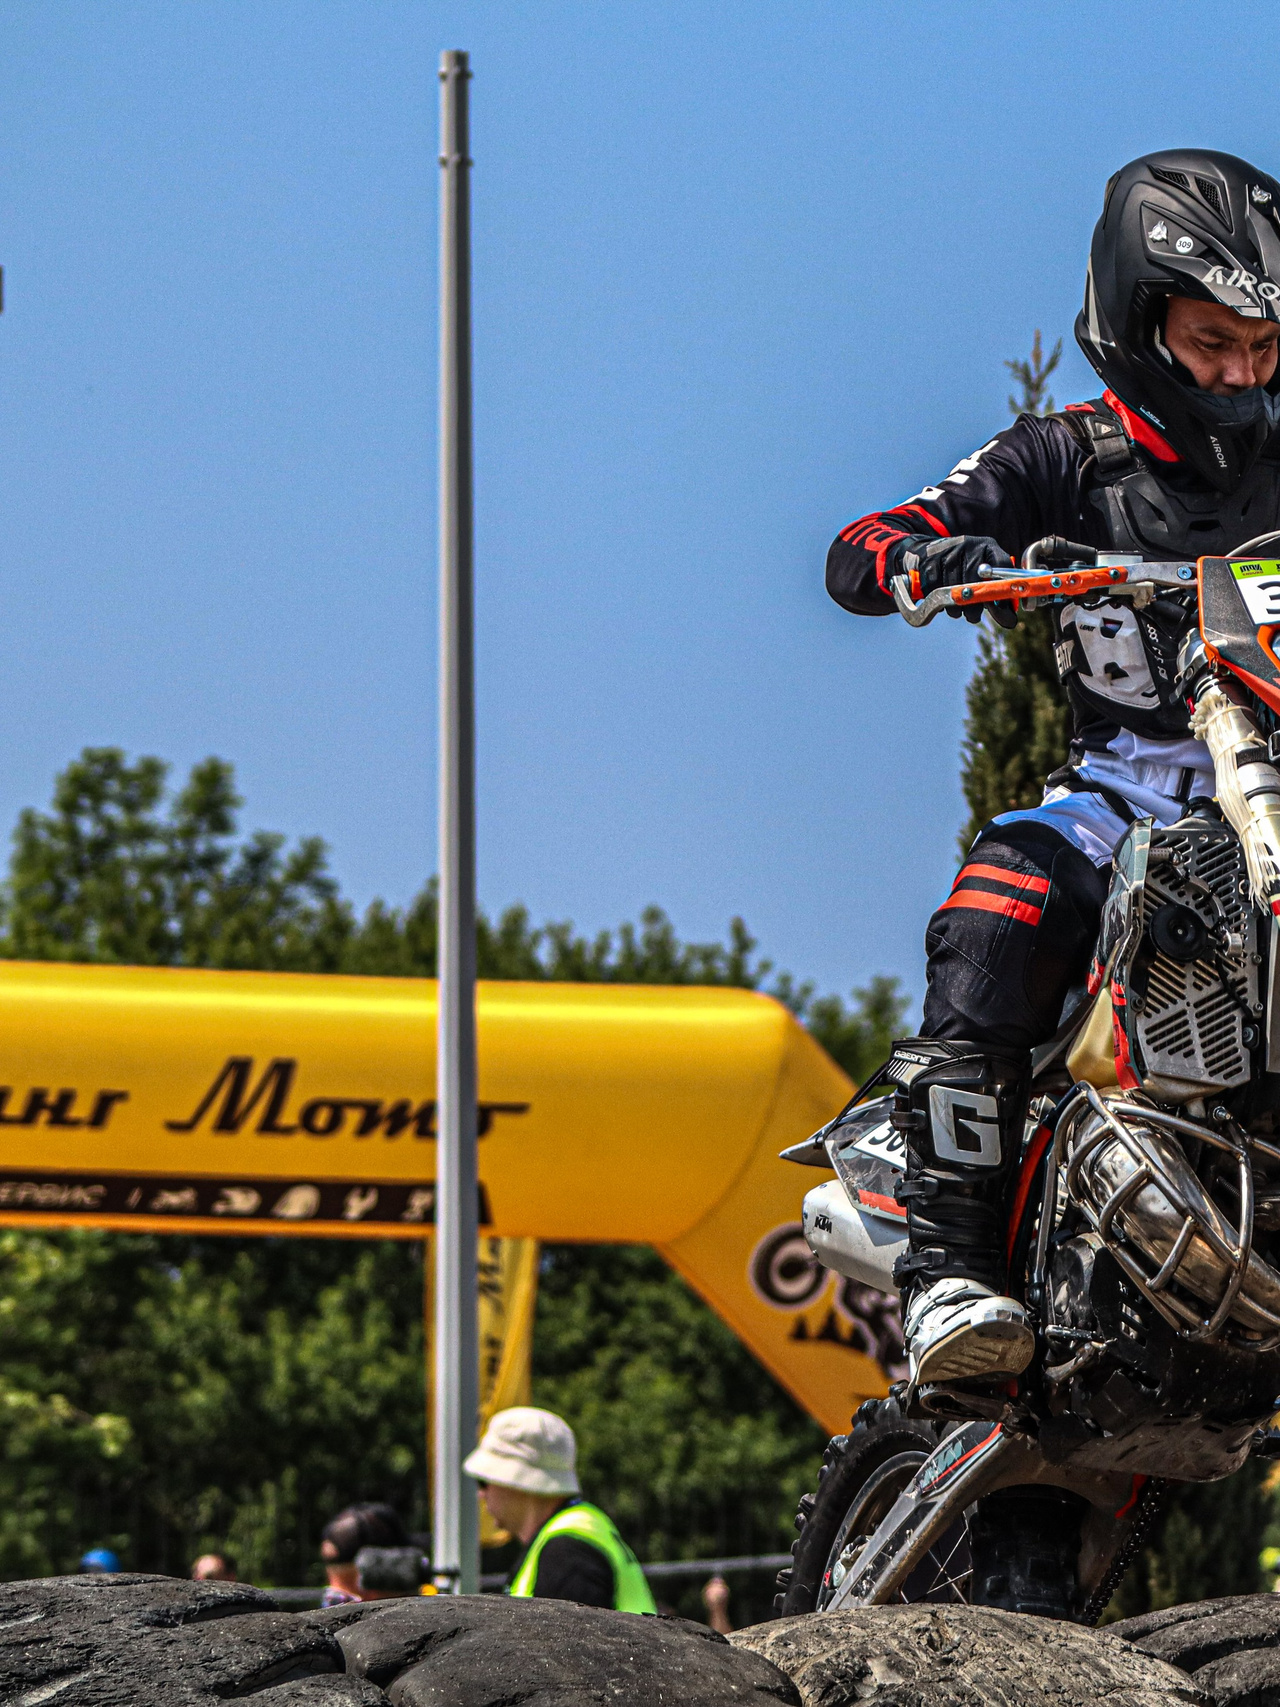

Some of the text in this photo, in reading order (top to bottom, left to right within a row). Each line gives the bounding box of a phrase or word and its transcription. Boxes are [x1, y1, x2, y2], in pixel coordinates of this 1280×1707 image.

[1177, 240, 1192, 249] 309
[1210, 435, 1228, 468] AIROH
[929, 1085, 1001, 1166] G
[814, 1213, 833, 1234] KTM
